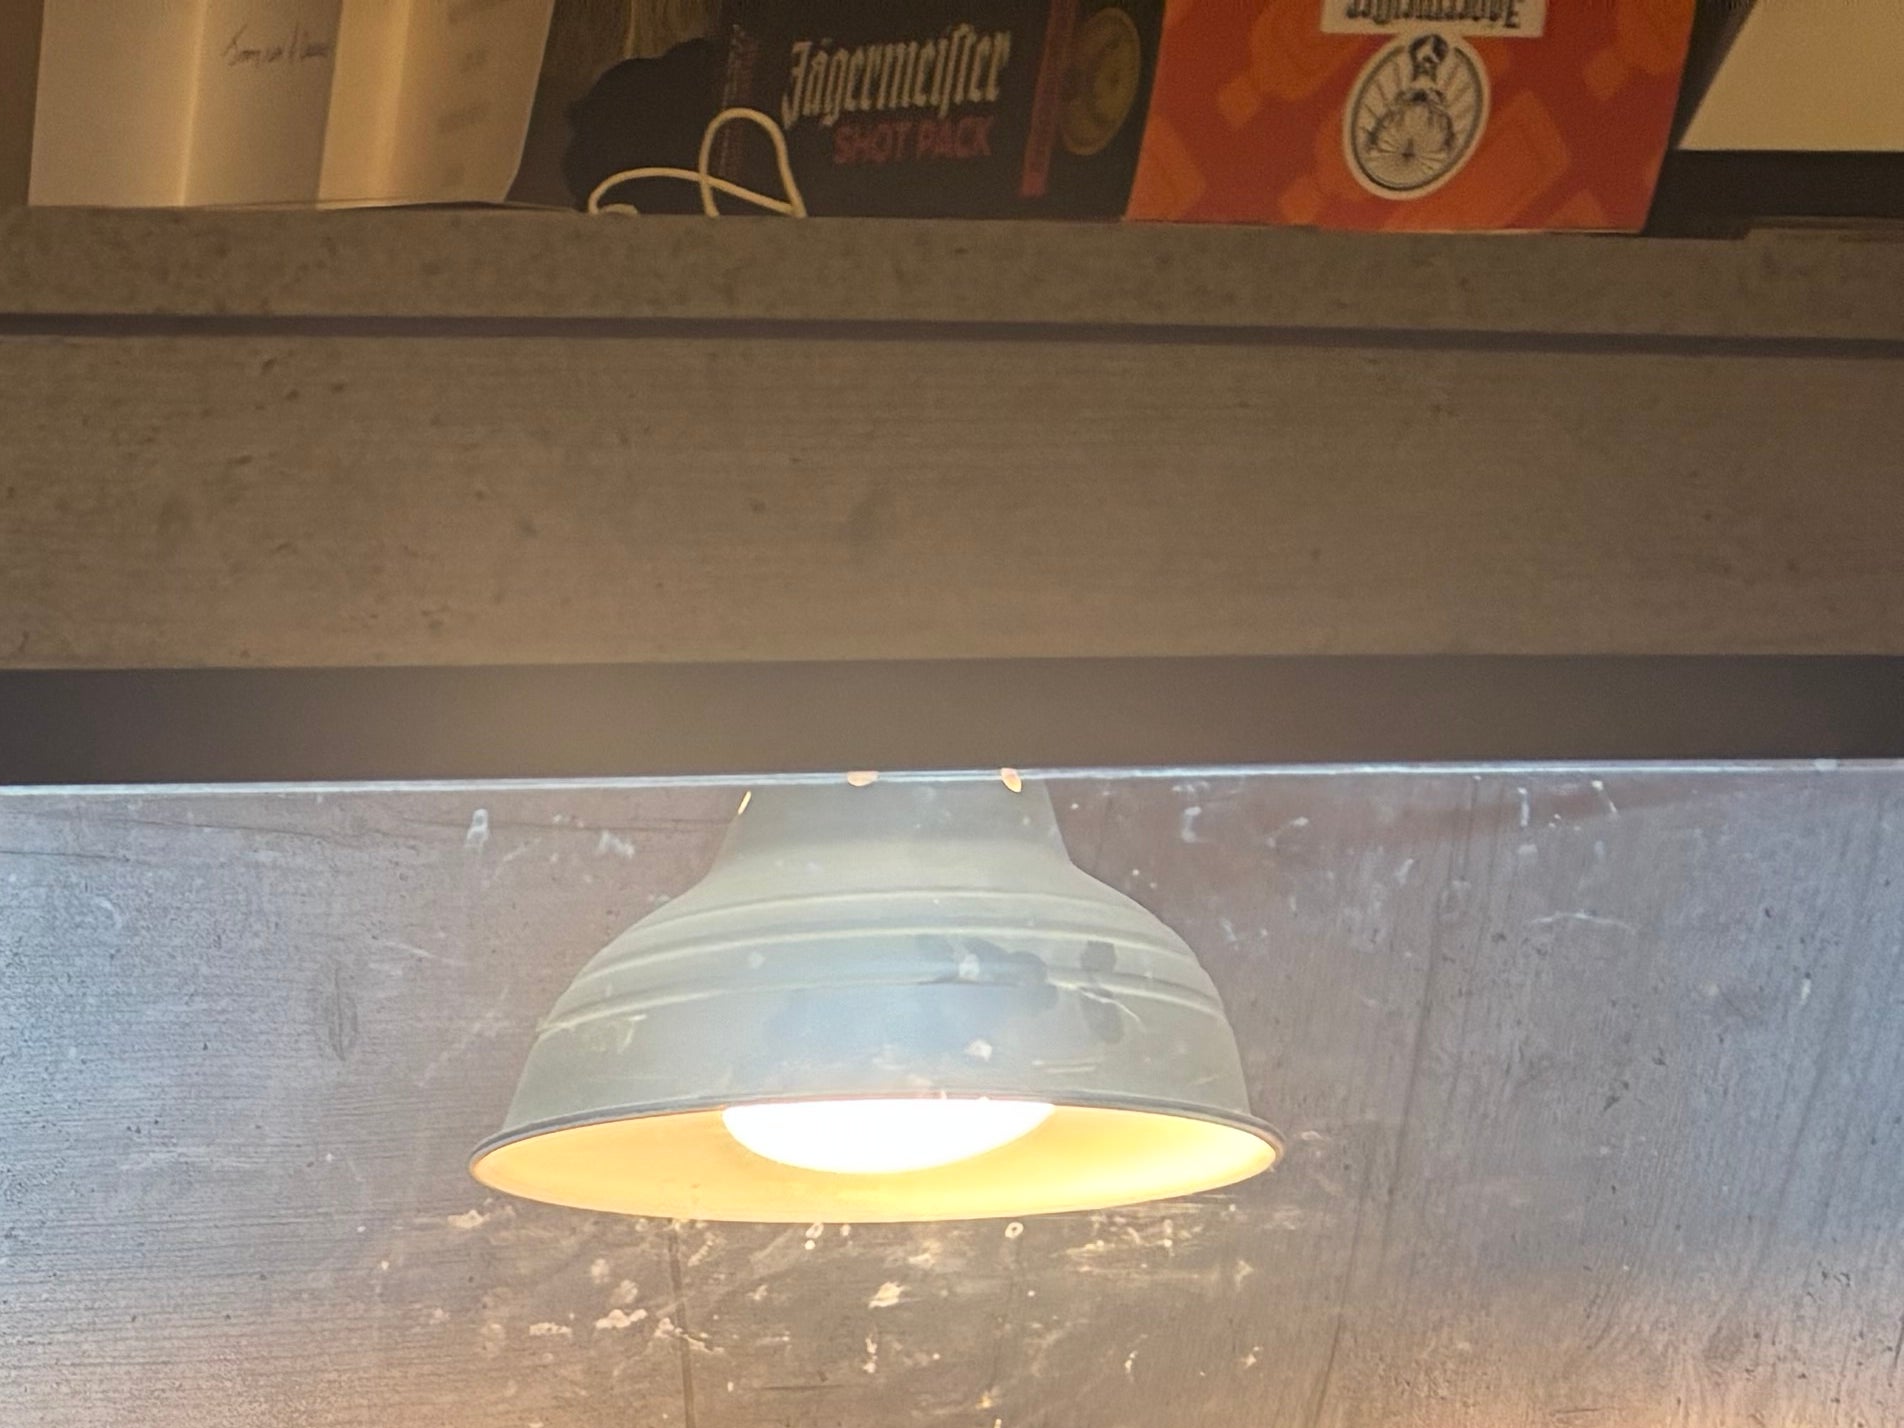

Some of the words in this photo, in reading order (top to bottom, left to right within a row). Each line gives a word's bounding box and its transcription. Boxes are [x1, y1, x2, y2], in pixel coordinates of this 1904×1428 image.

[781, 22, 1012, 130] Jägermeister
[834, 121, 913, 165] SHOT
[916, 115, 993, 160] PACK
